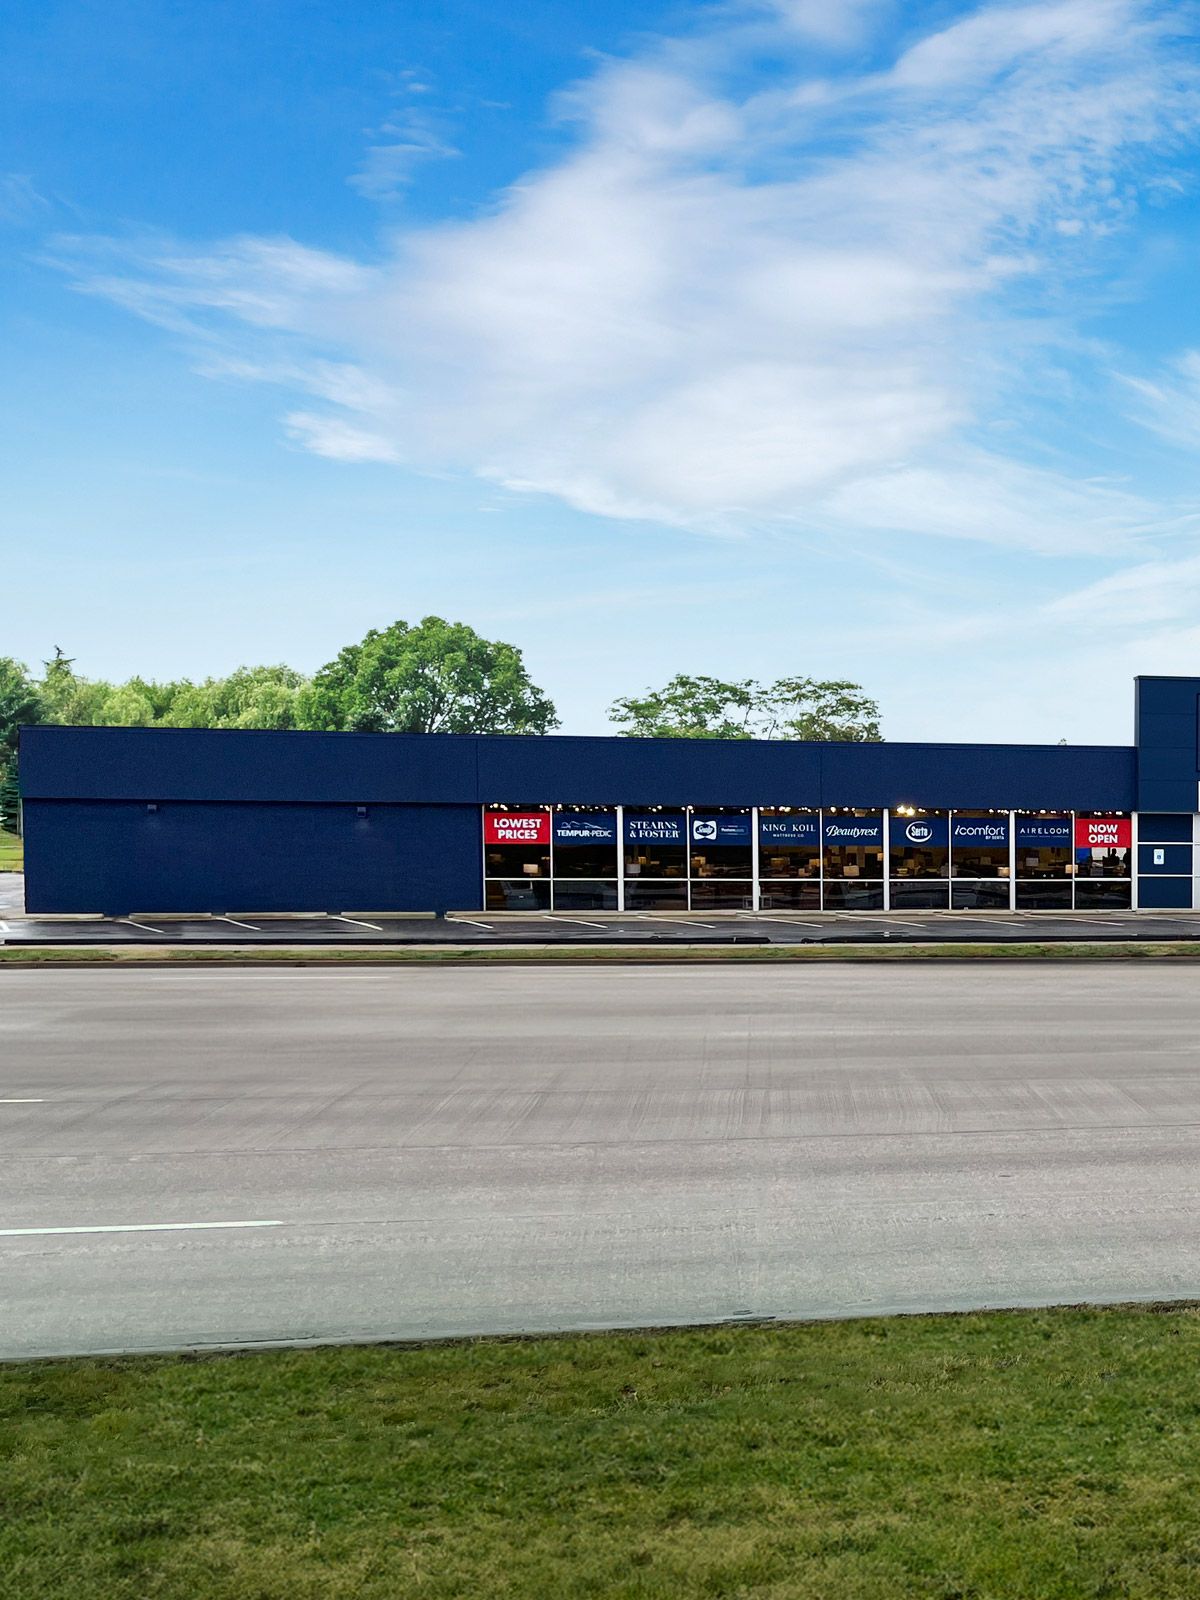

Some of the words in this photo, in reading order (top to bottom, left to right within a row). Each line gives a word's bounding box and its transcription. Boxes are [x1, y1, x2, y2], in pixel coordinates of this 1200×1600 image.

[493, 818, 542, 829] LOWEST
[629, 821, 678, 830] STEARNS
[762, 823, 787, 832] KING
[792, 823, 816, 832] KOIL
[825, 825, 879, 838] Beautyrest
[911, 825, 929, 837] Serta
[1019, 827, 1070, 835] AIRELOOM
[1088, 824, 1119, 833] NOW
[497, 829, 538, 840] PRICES
[556, 829, 613, 838] TEMPUR-PEDIC
[640, 830, 679, 839] FOSTER
[1088, 834, 1119, 844] OPEN
